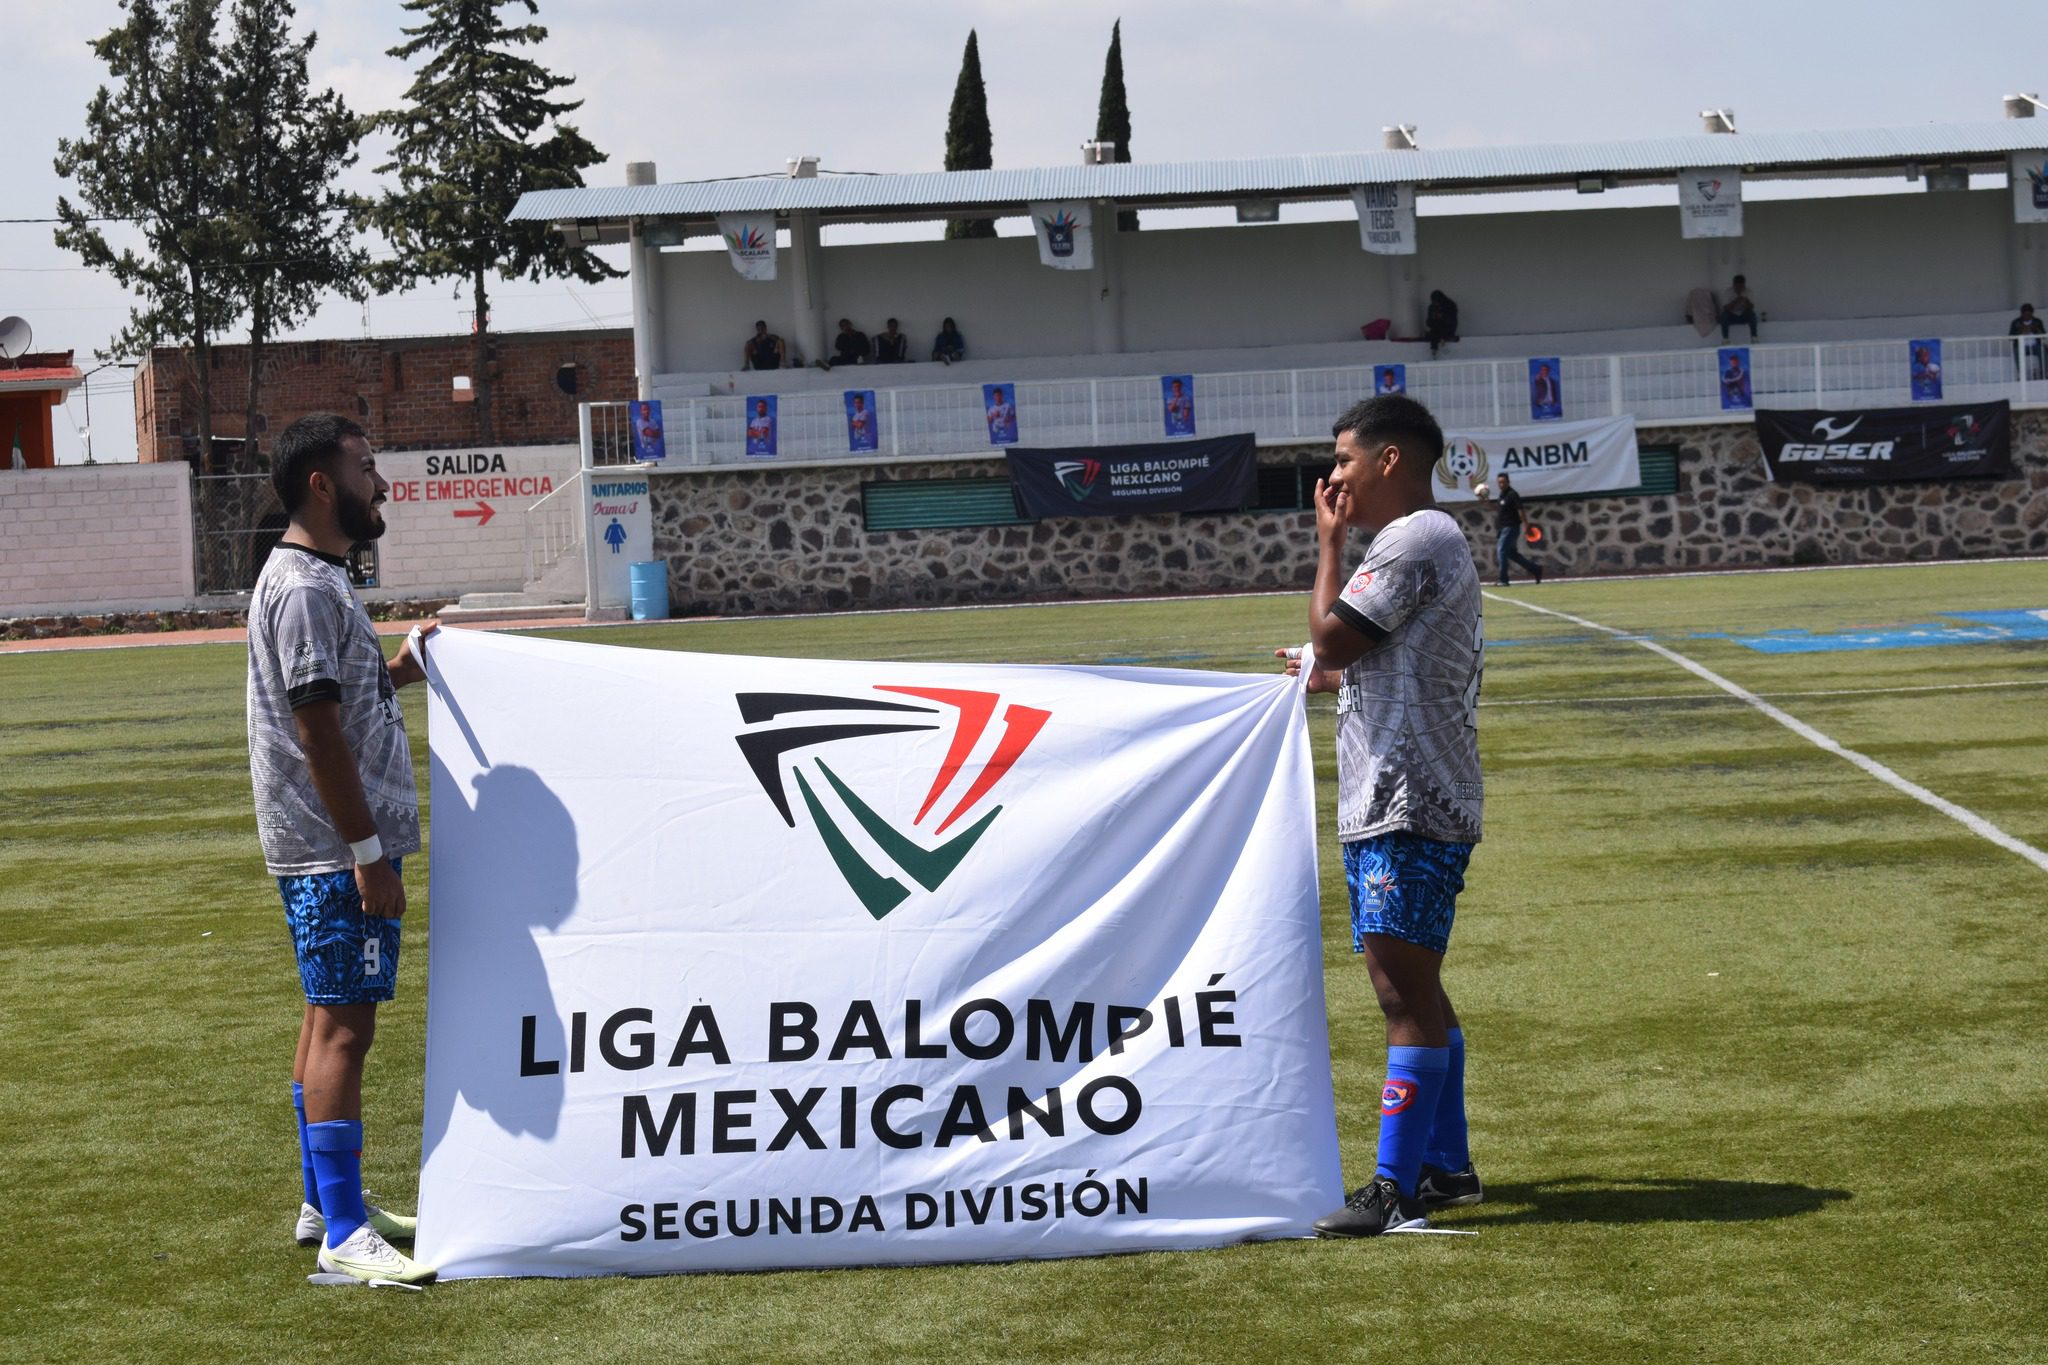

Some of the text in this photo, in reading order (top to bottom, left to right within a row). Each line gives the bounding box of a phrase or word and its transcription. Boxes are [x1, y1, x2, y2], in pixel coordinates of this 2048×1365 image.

[426, 454, 506, 475] SALIDA
[1110, 454, 1210, 474] LIGA BALOMPIÉ
[1503, 441, 1588, 468] ANBM
[392, 476, 553, 501] DE EMERGENCIA
[592, 482, 648, 497] ANITARIOS
[1110, 471, 1181, 486] MEXICANO
[1112, 488, 1147, 497] SEGUNDA
[364, 937, 380, 975] 9
[520, 973, 1242, 1077] LIGA BALOMPIÉ
[621, 1075, 1142, 1158] MEXICANO
[620, 1169, 1148, 1242] SEGUNDA DIVISIÓN
